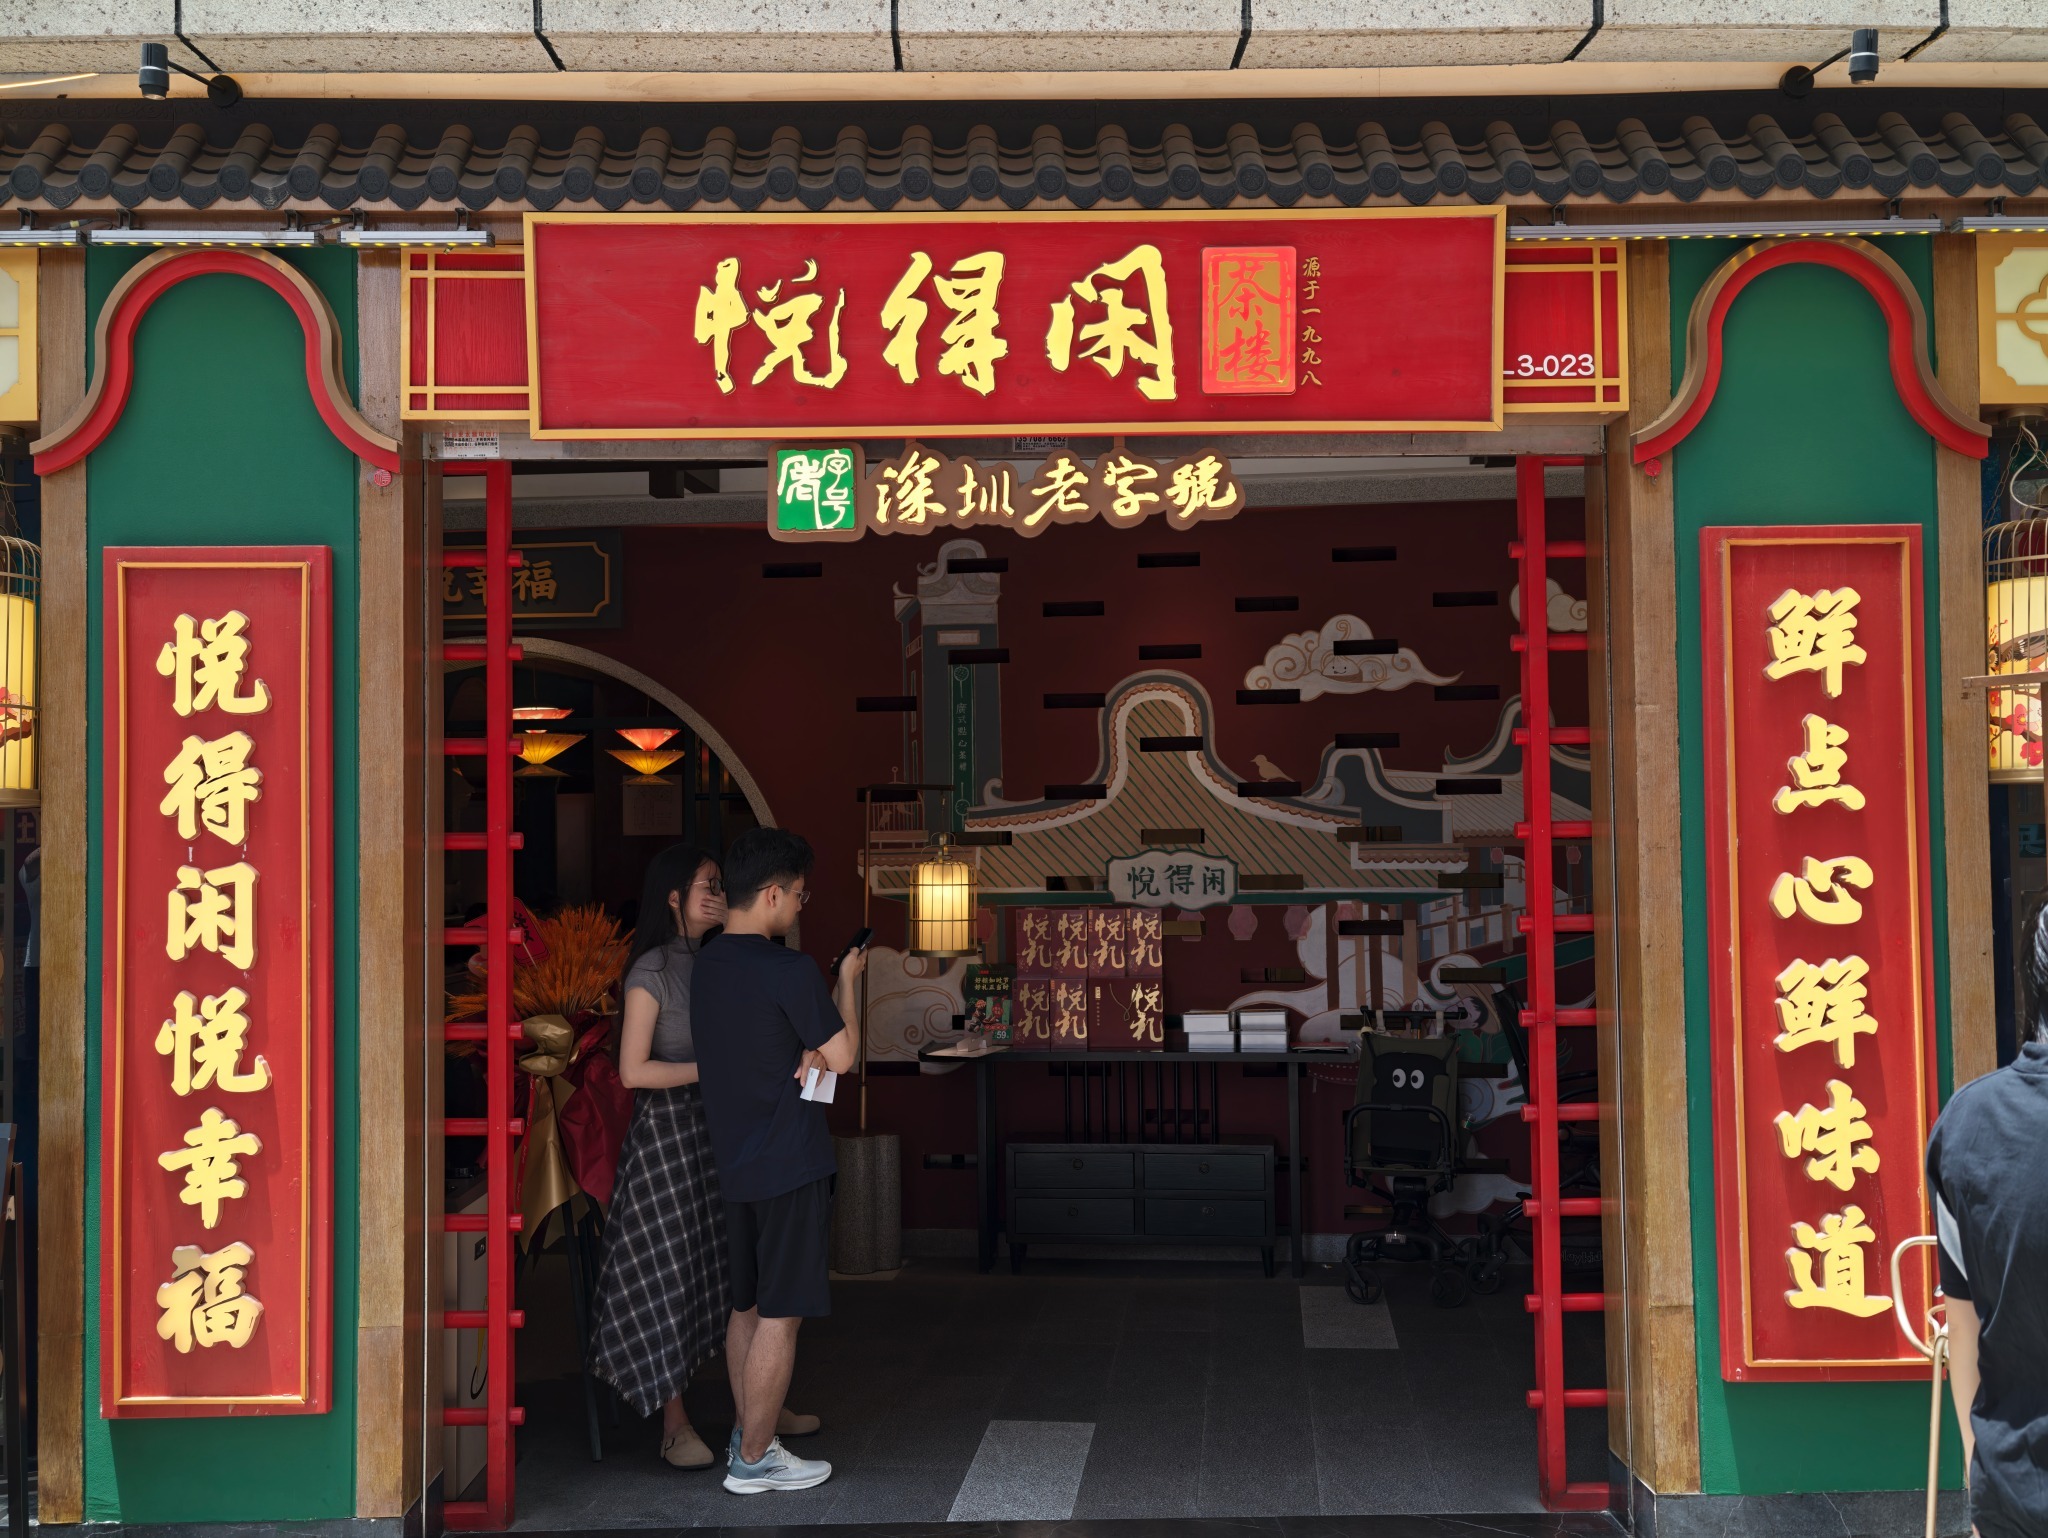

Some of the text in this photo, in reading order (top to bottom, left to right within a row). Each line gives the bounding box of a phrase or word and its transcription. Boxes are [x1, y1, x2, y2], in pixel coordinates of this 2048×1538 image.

[1217, 258, 1282, 384] 茶楼
[1301, 256, 1323, 386] 源于一九九八
[1127, 863, 1226, 900] 悦得闲
[156, 609, 272, 1356] 悦得闲悦幸福
[1764, 587, 1893, 1318] 鲜点心鲜味道
